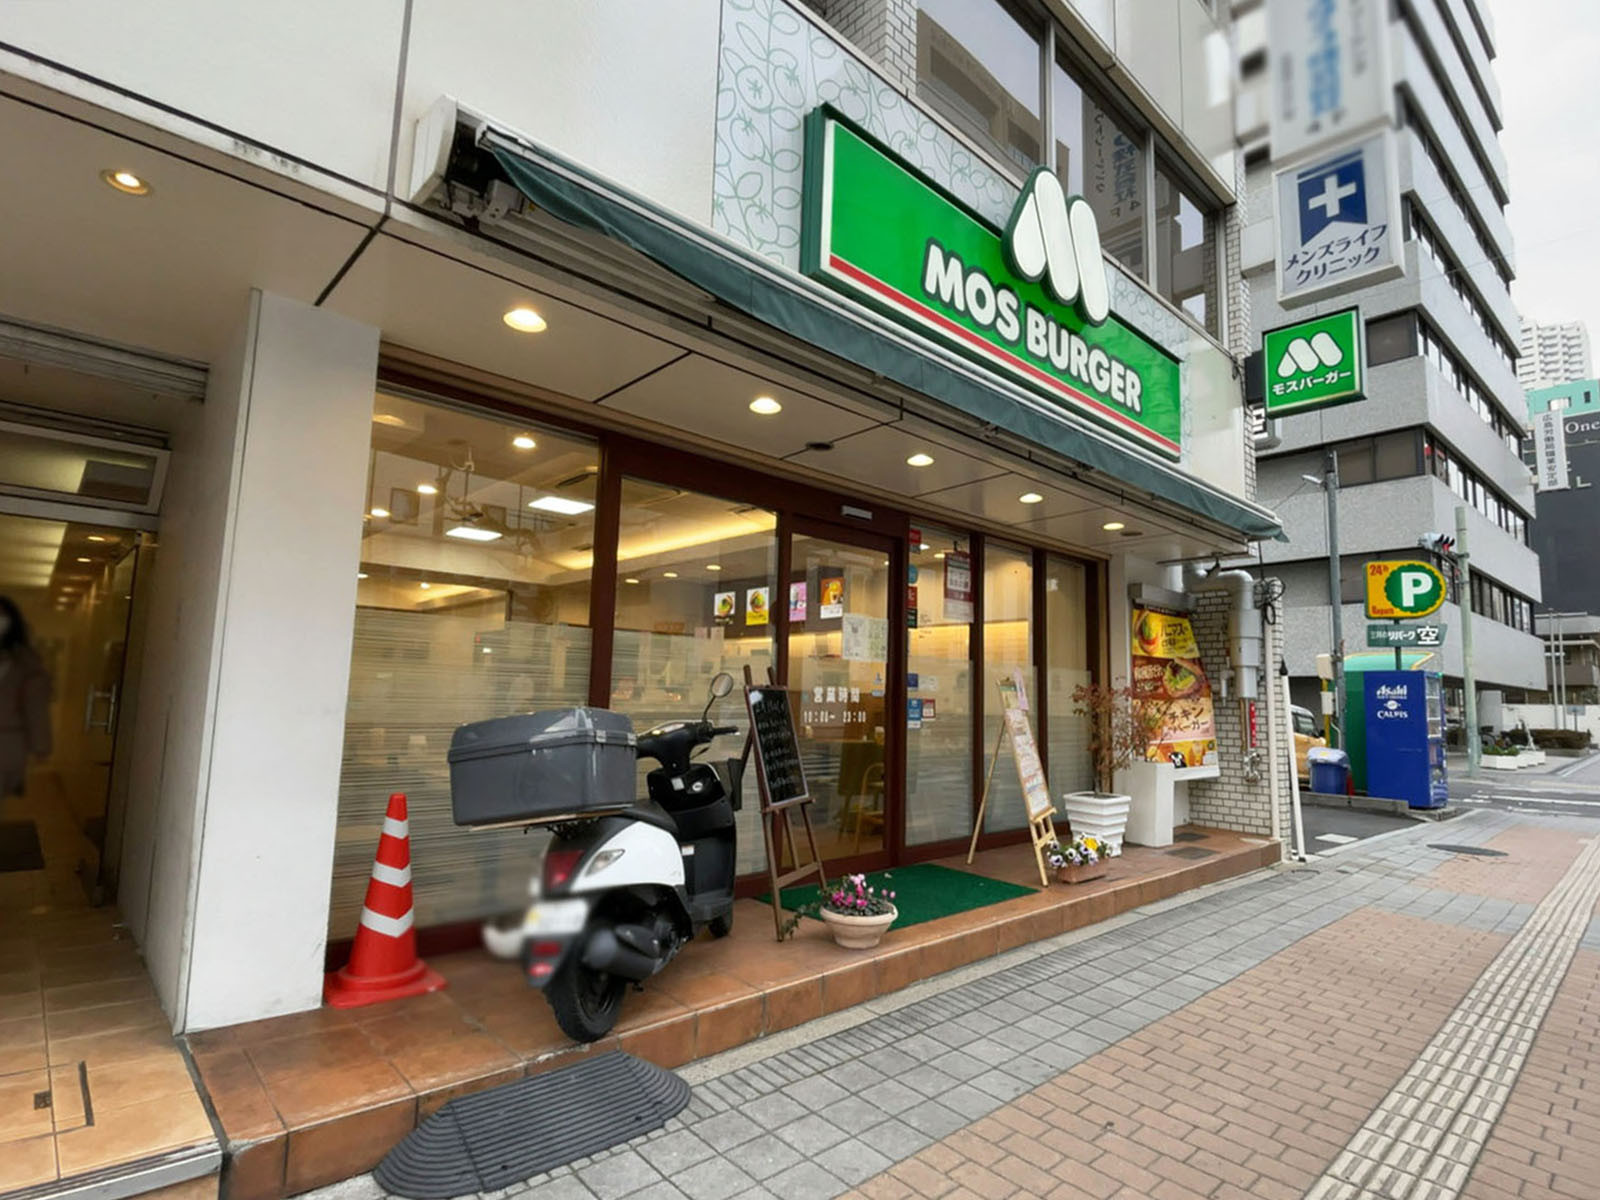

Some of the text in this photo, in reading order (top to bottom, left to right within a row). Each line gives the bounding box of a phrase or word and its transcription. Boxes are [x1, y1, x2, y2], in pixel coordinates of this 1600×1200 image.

[1285, 224, 1387, 272] メンズライフ
[1296, 246, 1380, 286] クリニック
[925, 244, 1141, 412] MOS BURGER
[1272, 370, 1352, 395] モスバーガー
[1401, 572, 1433, 607] P
[1417, 626, 1440, 645] 空
